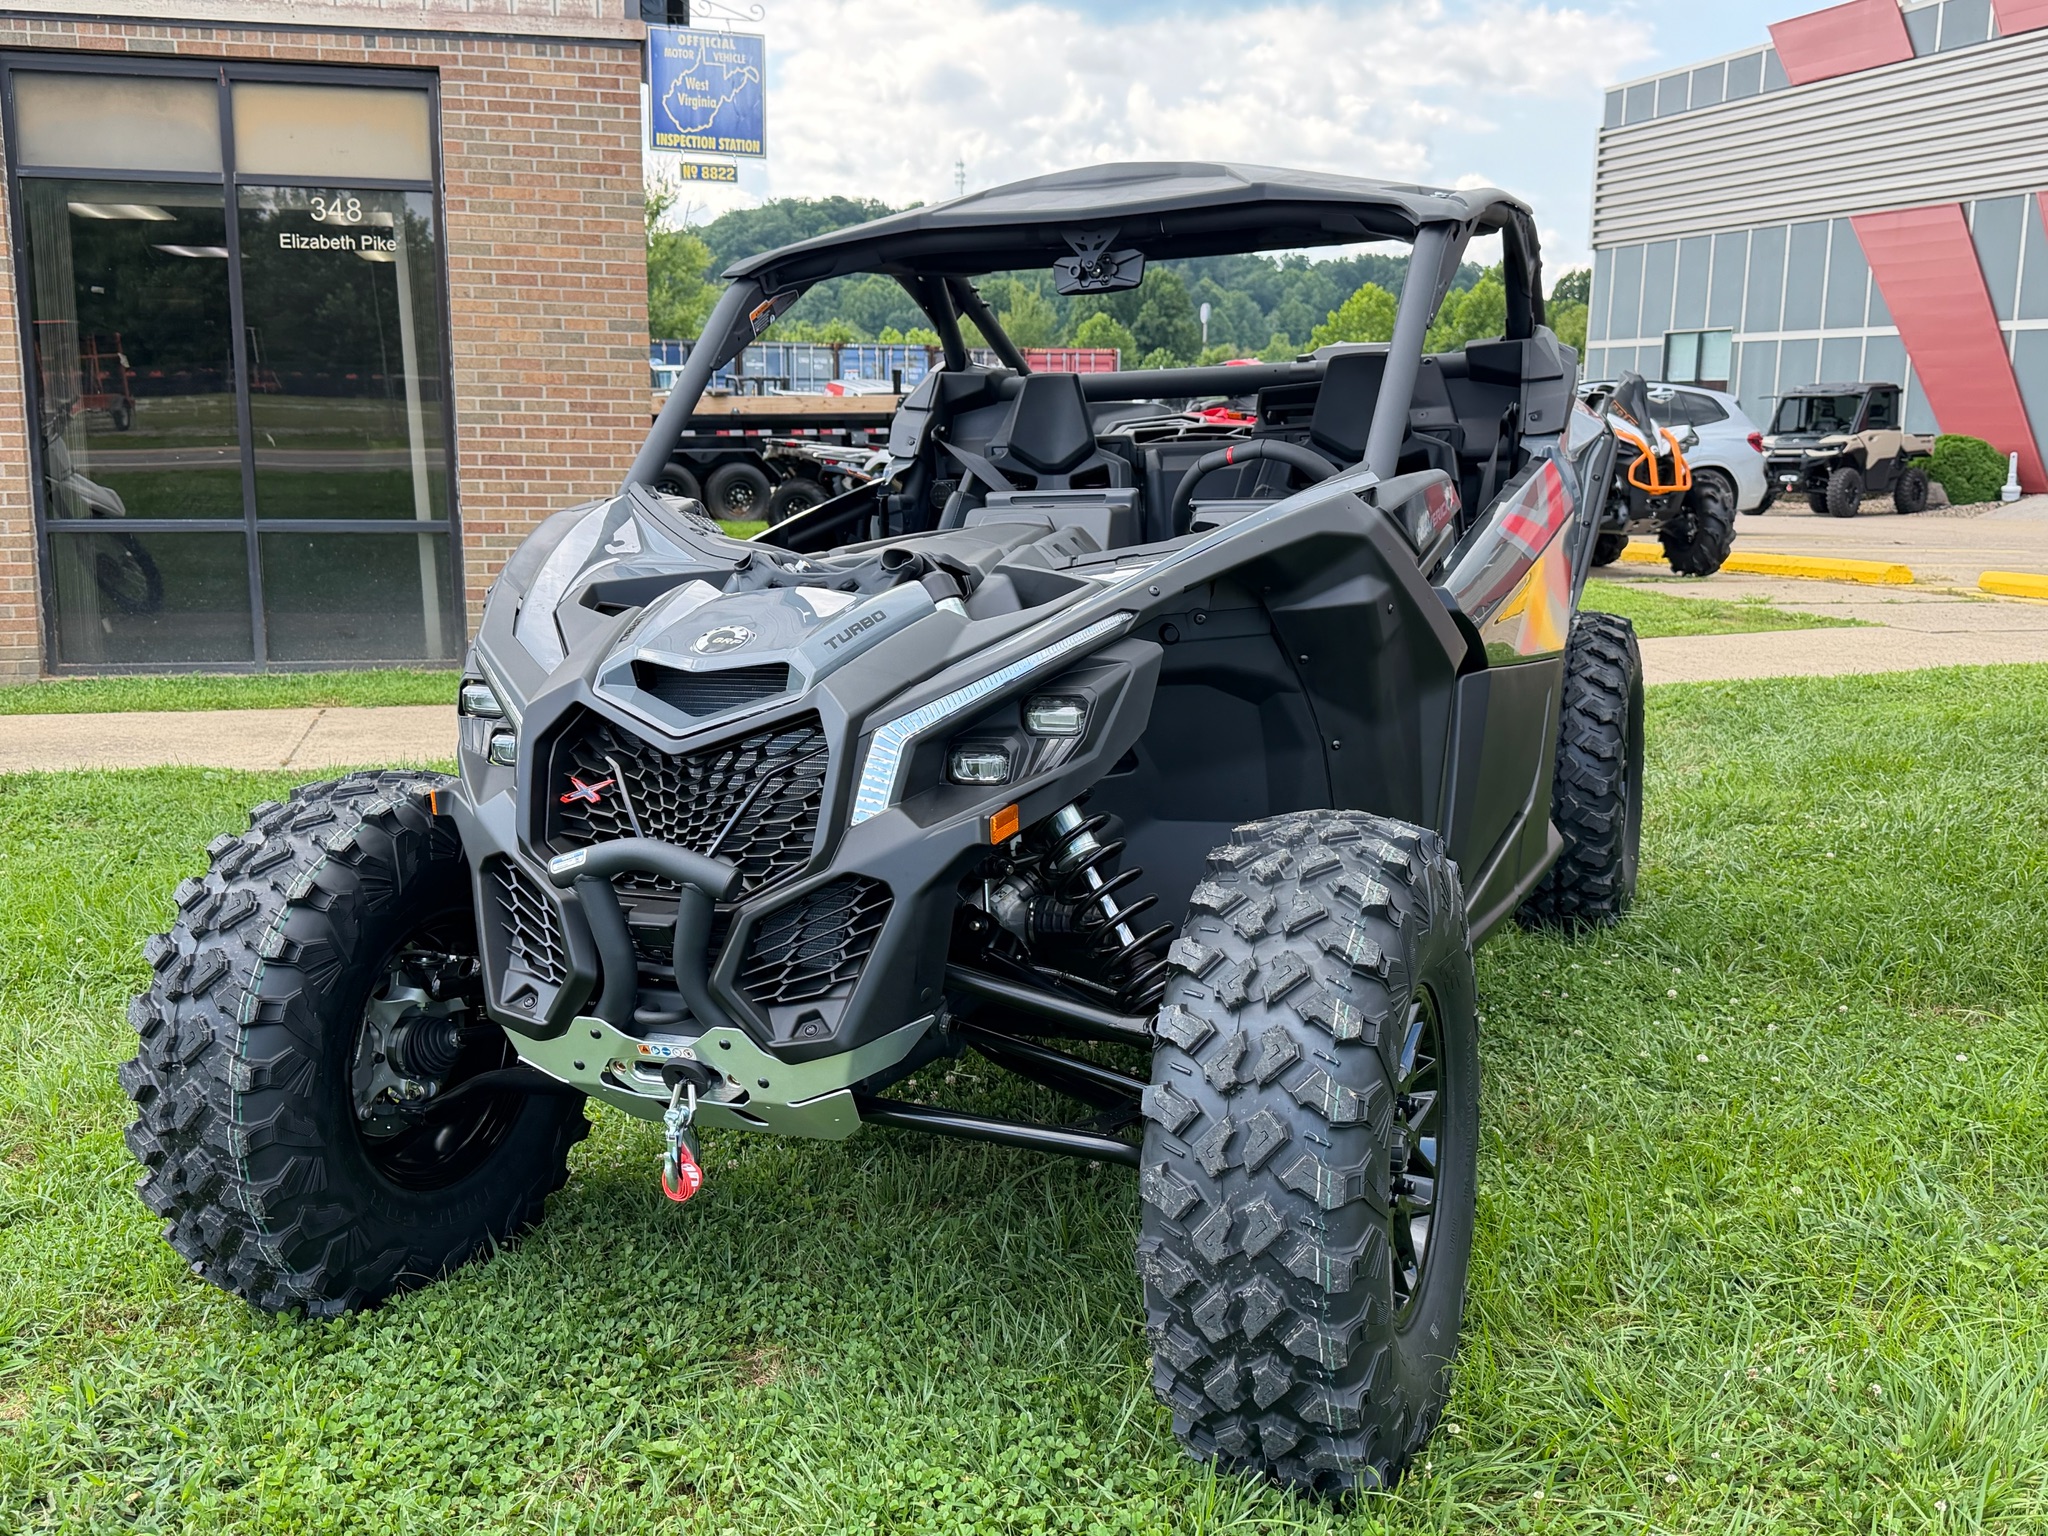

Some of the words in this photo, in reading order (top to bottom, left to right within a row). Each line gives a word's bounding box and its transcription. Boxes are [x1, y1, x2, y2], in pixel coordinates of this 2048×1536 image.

[678, 34, 736, 50] OFFICIAL
[664, 48, 694, 59] MOTOR
[713, 52, 747, 64] VEHICLE
[685, 77, 709, 91] West
[677, 93, 717, 110] Virginia
[656, 133, 716, 150] INSPECTION
[718, 138, 760, 153] STATION
[701, 167, 735, 181] 8822
[310, 197, 362, 222] 348
[279, 233, 356, 250] Elizabeth
[361, 235, 397, 251] Pike
[823, 610, 887, 650] TURBO
[711, 637, 743, 645] BRP
